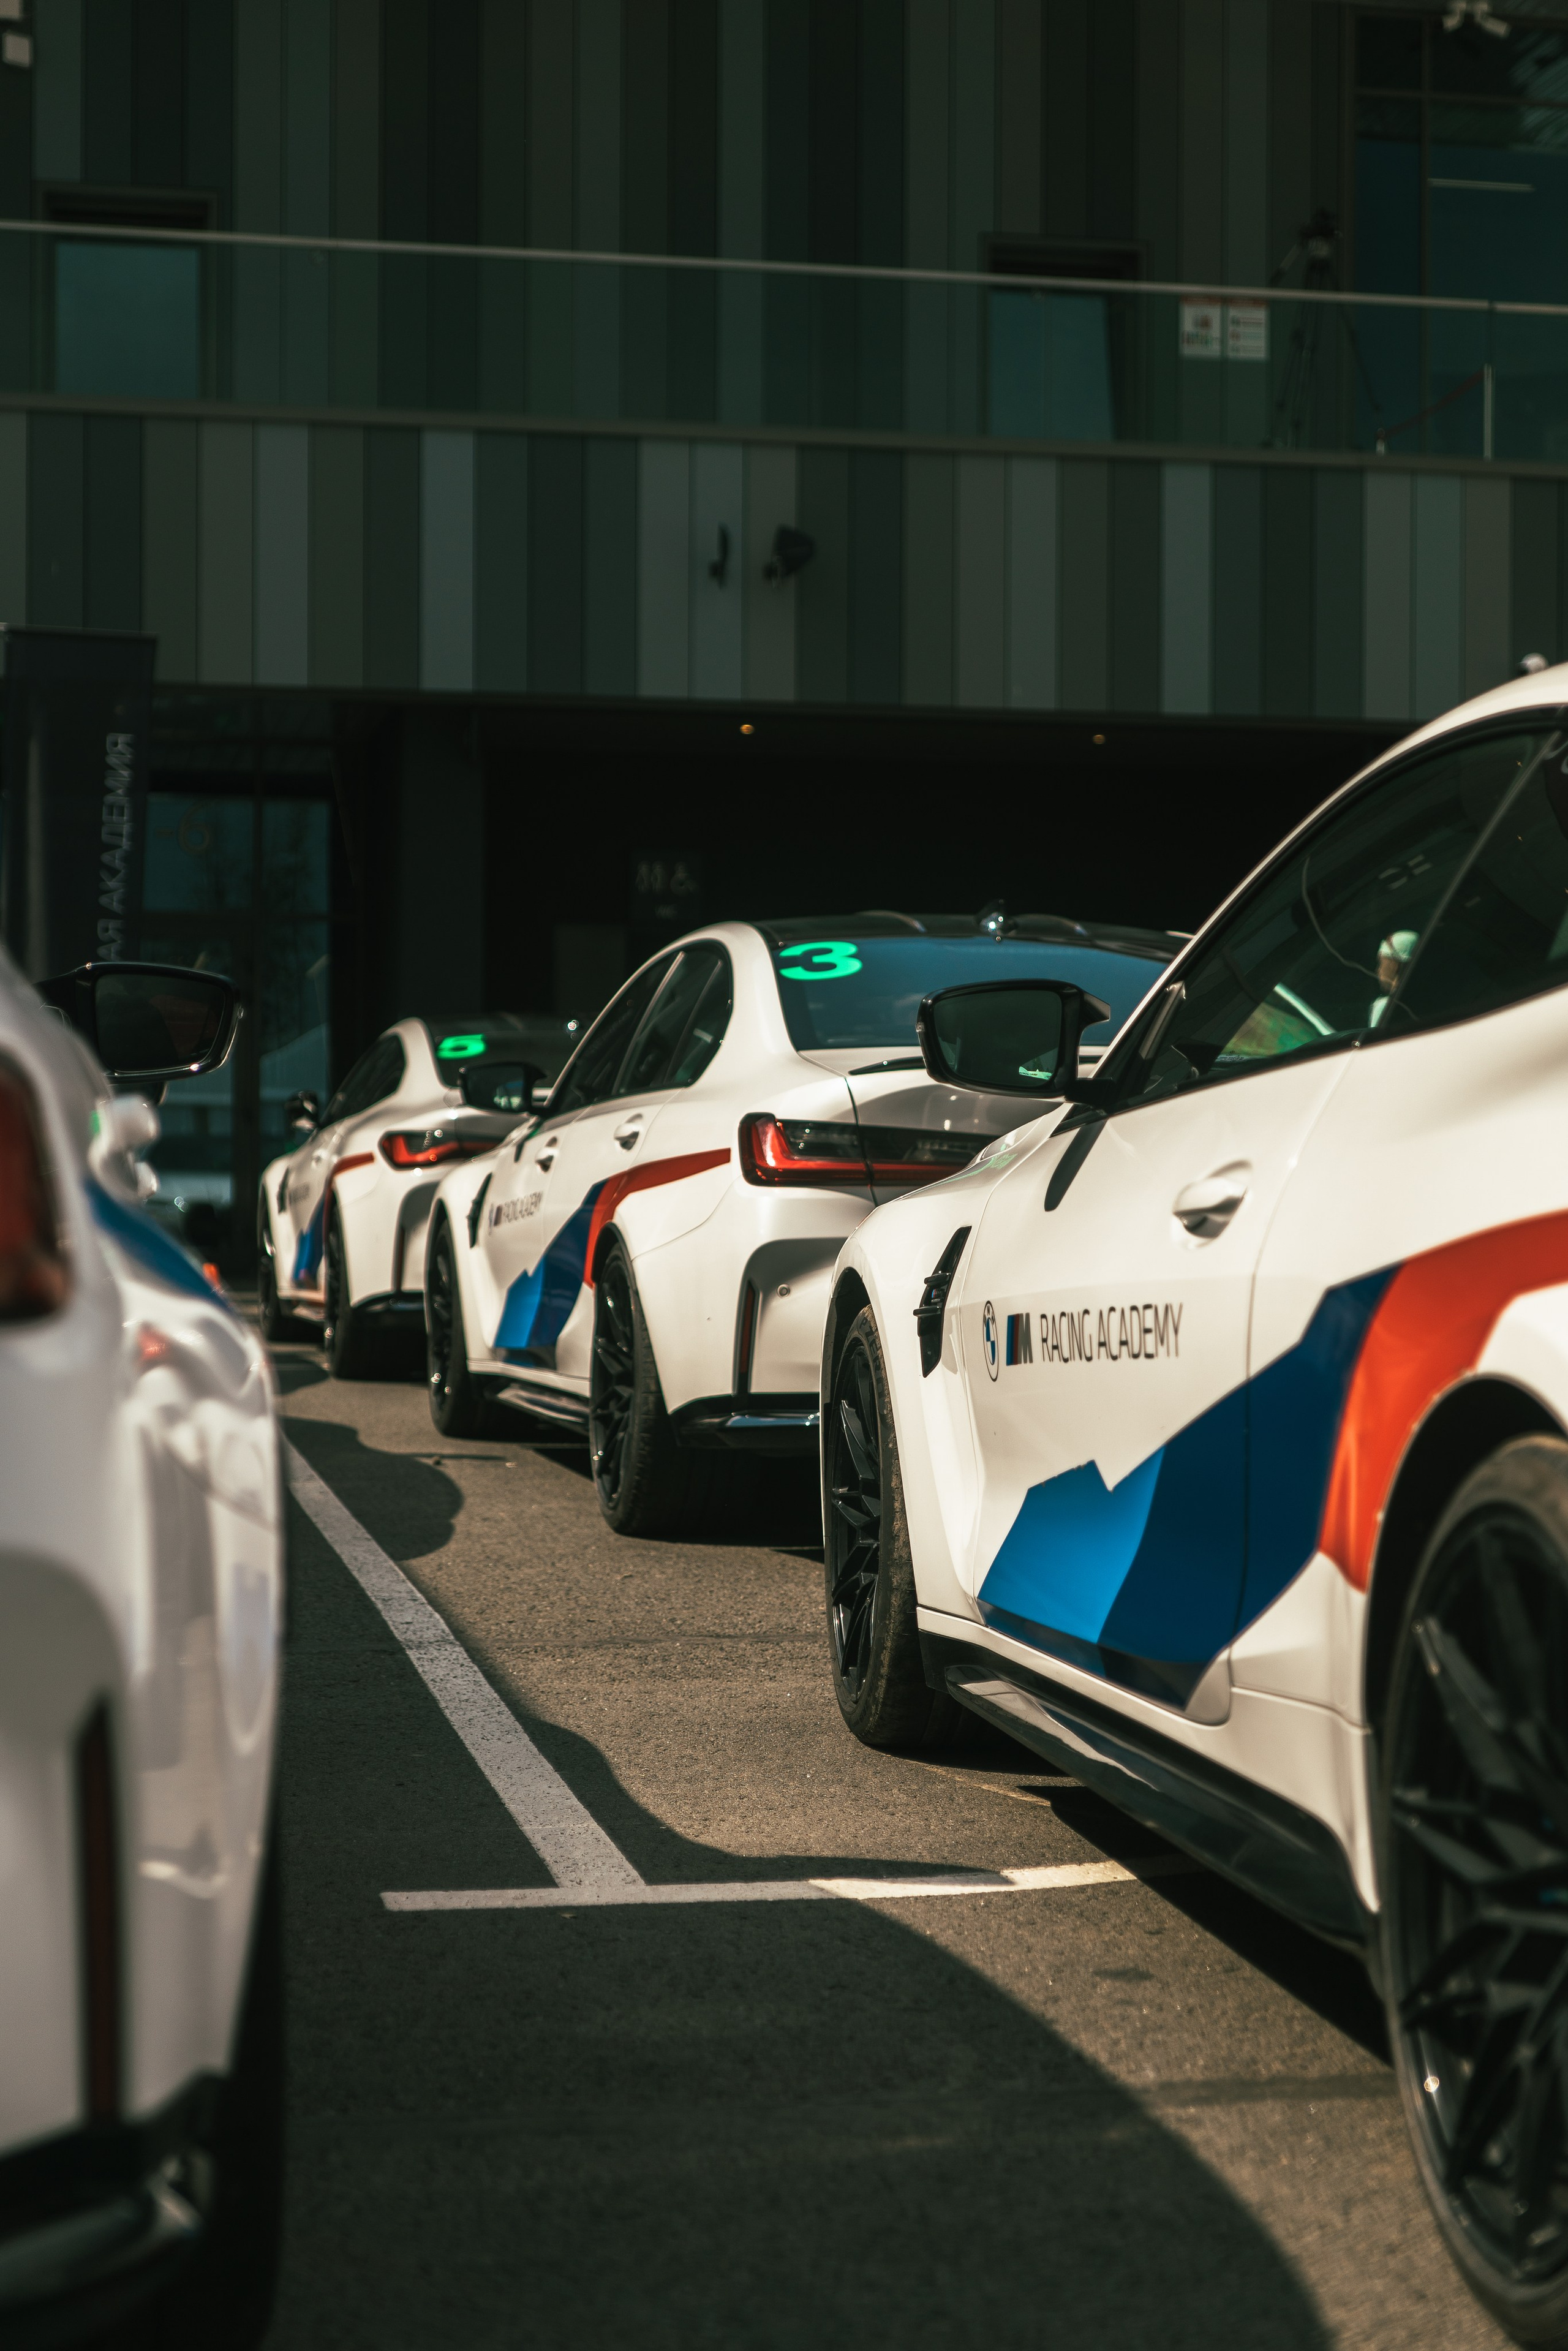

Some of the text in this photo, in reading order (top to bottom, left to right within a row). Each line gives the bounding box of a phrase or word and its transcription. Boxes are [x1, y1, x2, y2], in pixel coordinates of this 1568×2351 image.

[98, 733, 134, 915] АКАДЕМИЯ
[779, 941, 862, 980] 3
[1040, 1308, 1093, 1363] RACING
[1098, 1302, 1183, 1360] ACADEMY
